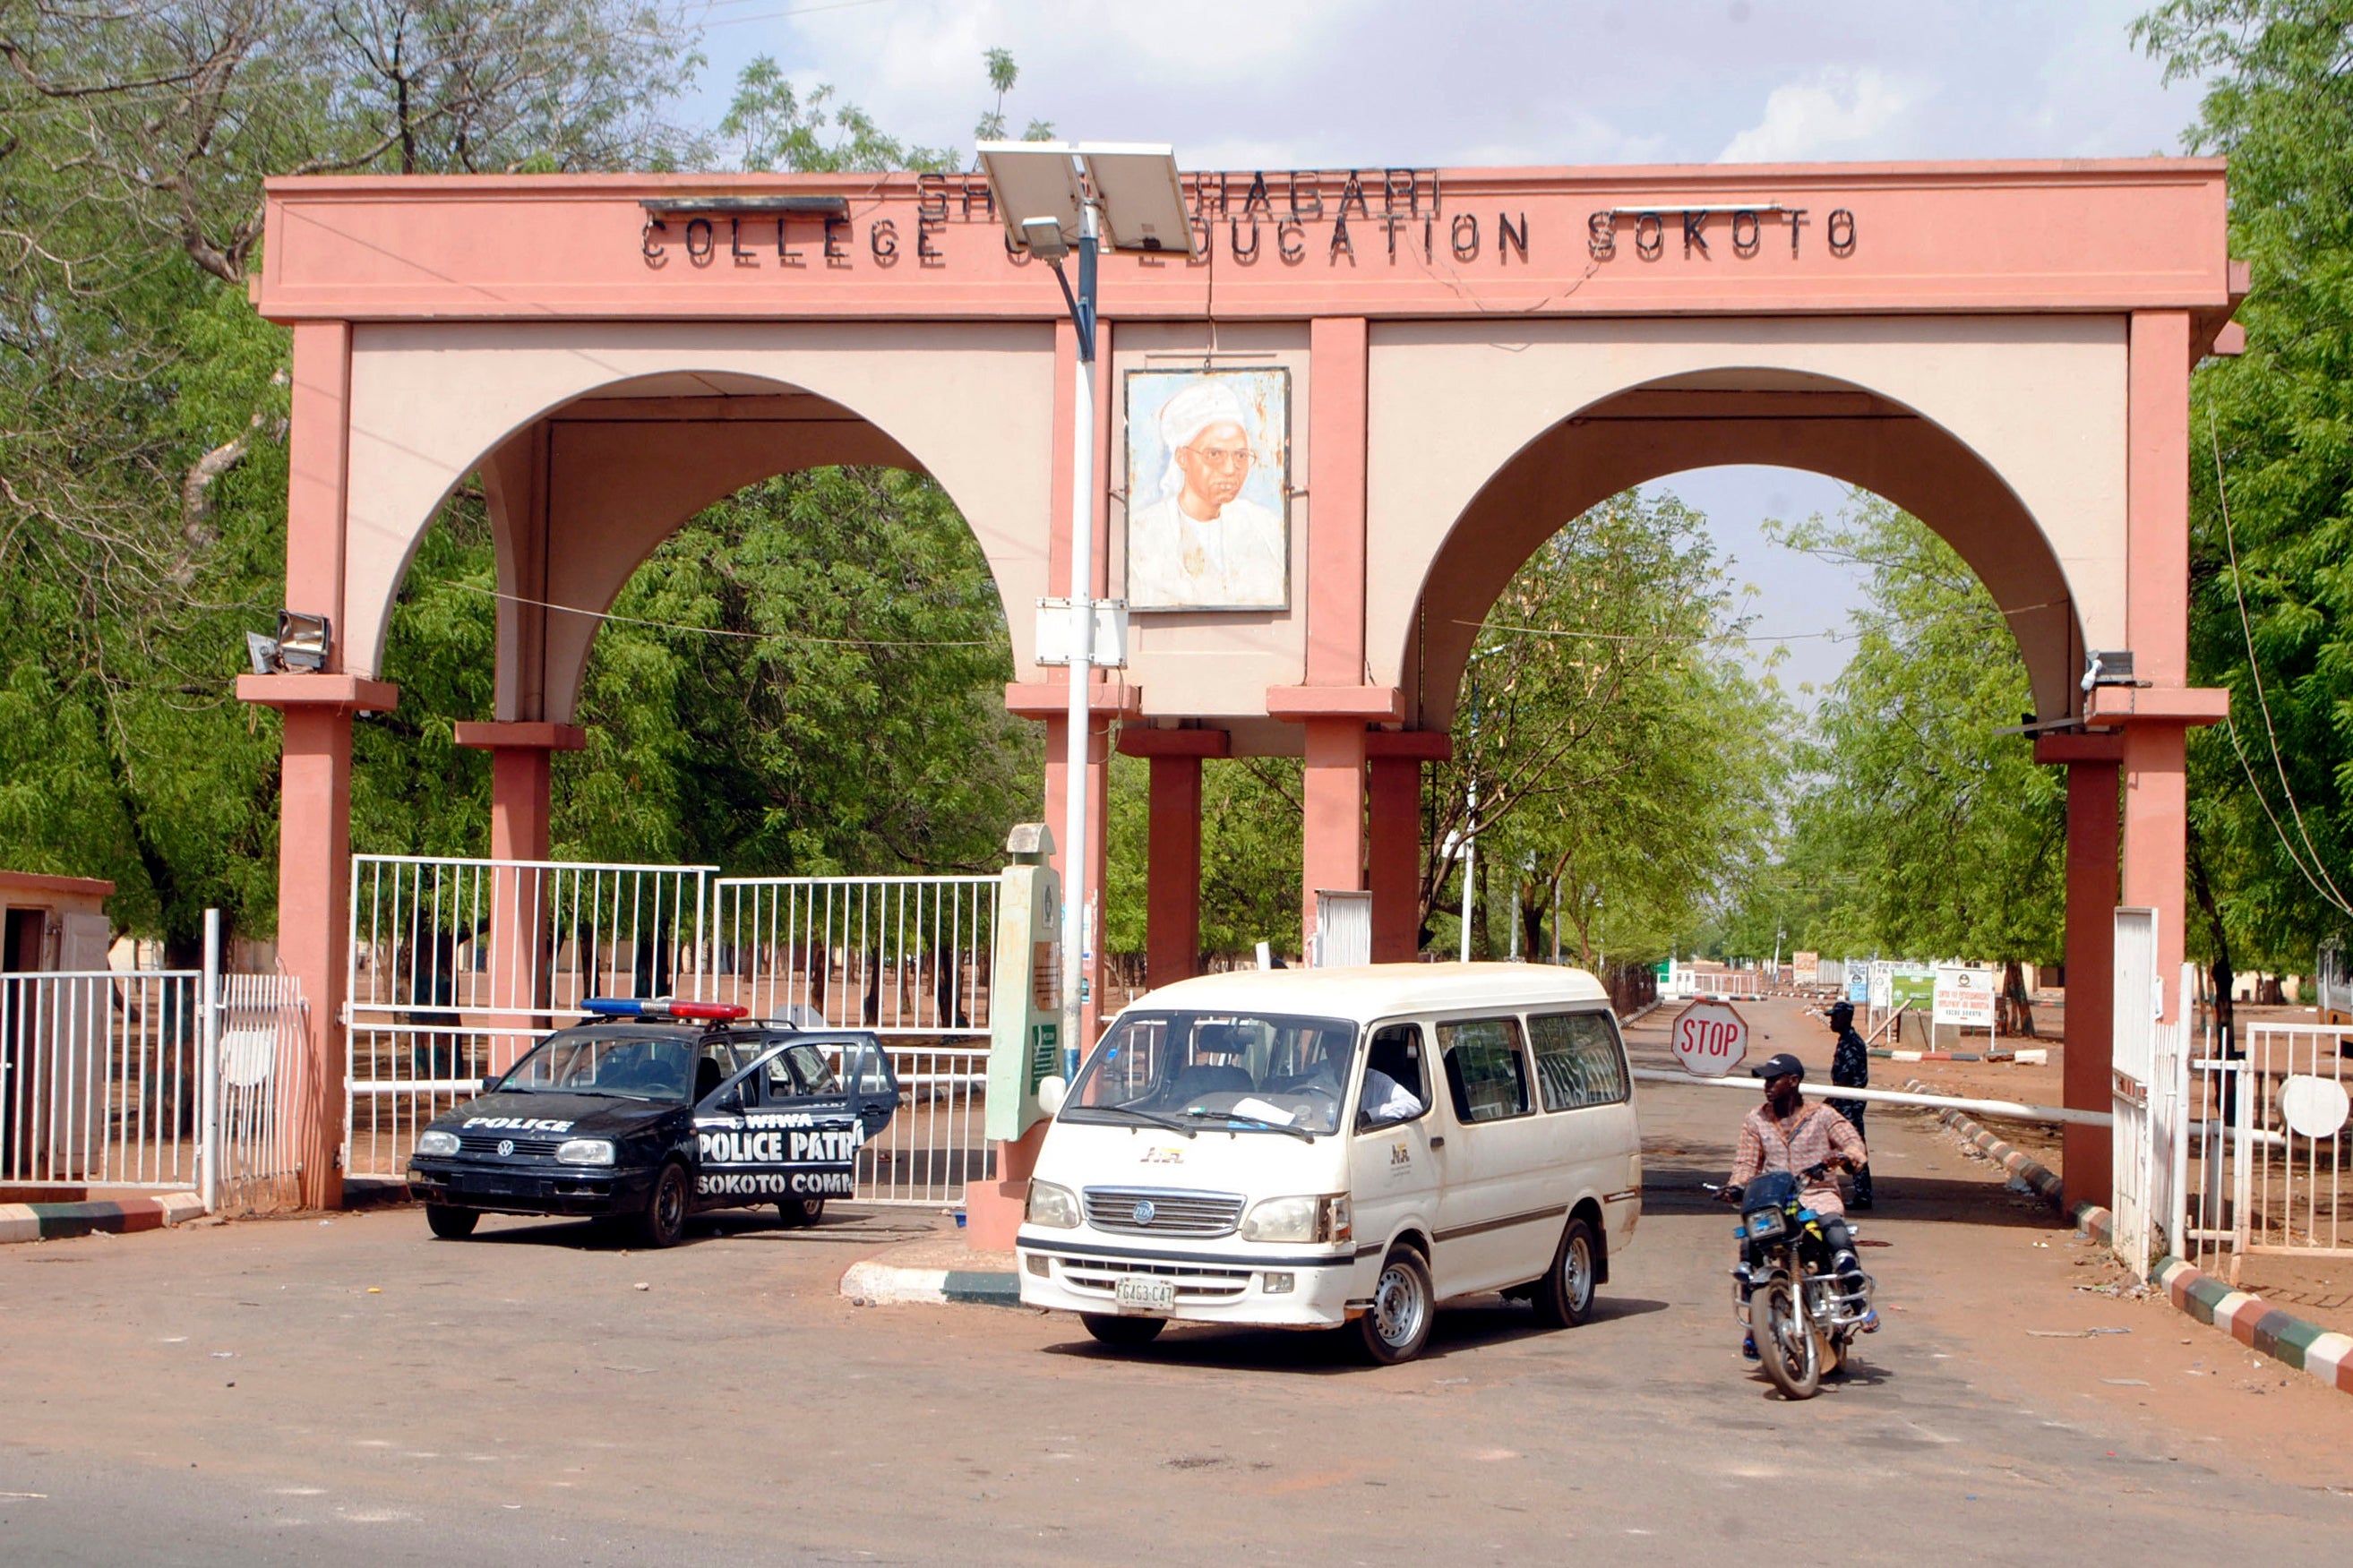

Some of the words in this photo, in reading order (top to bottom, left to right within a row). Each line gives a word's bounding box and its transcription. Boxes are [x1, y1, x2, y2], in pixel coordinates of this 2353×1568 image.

[1195, 167, 1438, 213] HAGARI
[642, 217, 943, 258] COLLEGE
[1189, 211, 1528, 256] DUCATION
[1588, 209, 1855, 251] SOKOTO
[1681, 1018, 1739, 1058] STOP
[463, 1117, 575, 1133] POLICE
[699, 1132, 784, 1162] POLICE
[697, 1173, 786, 1195] SOKOTO
